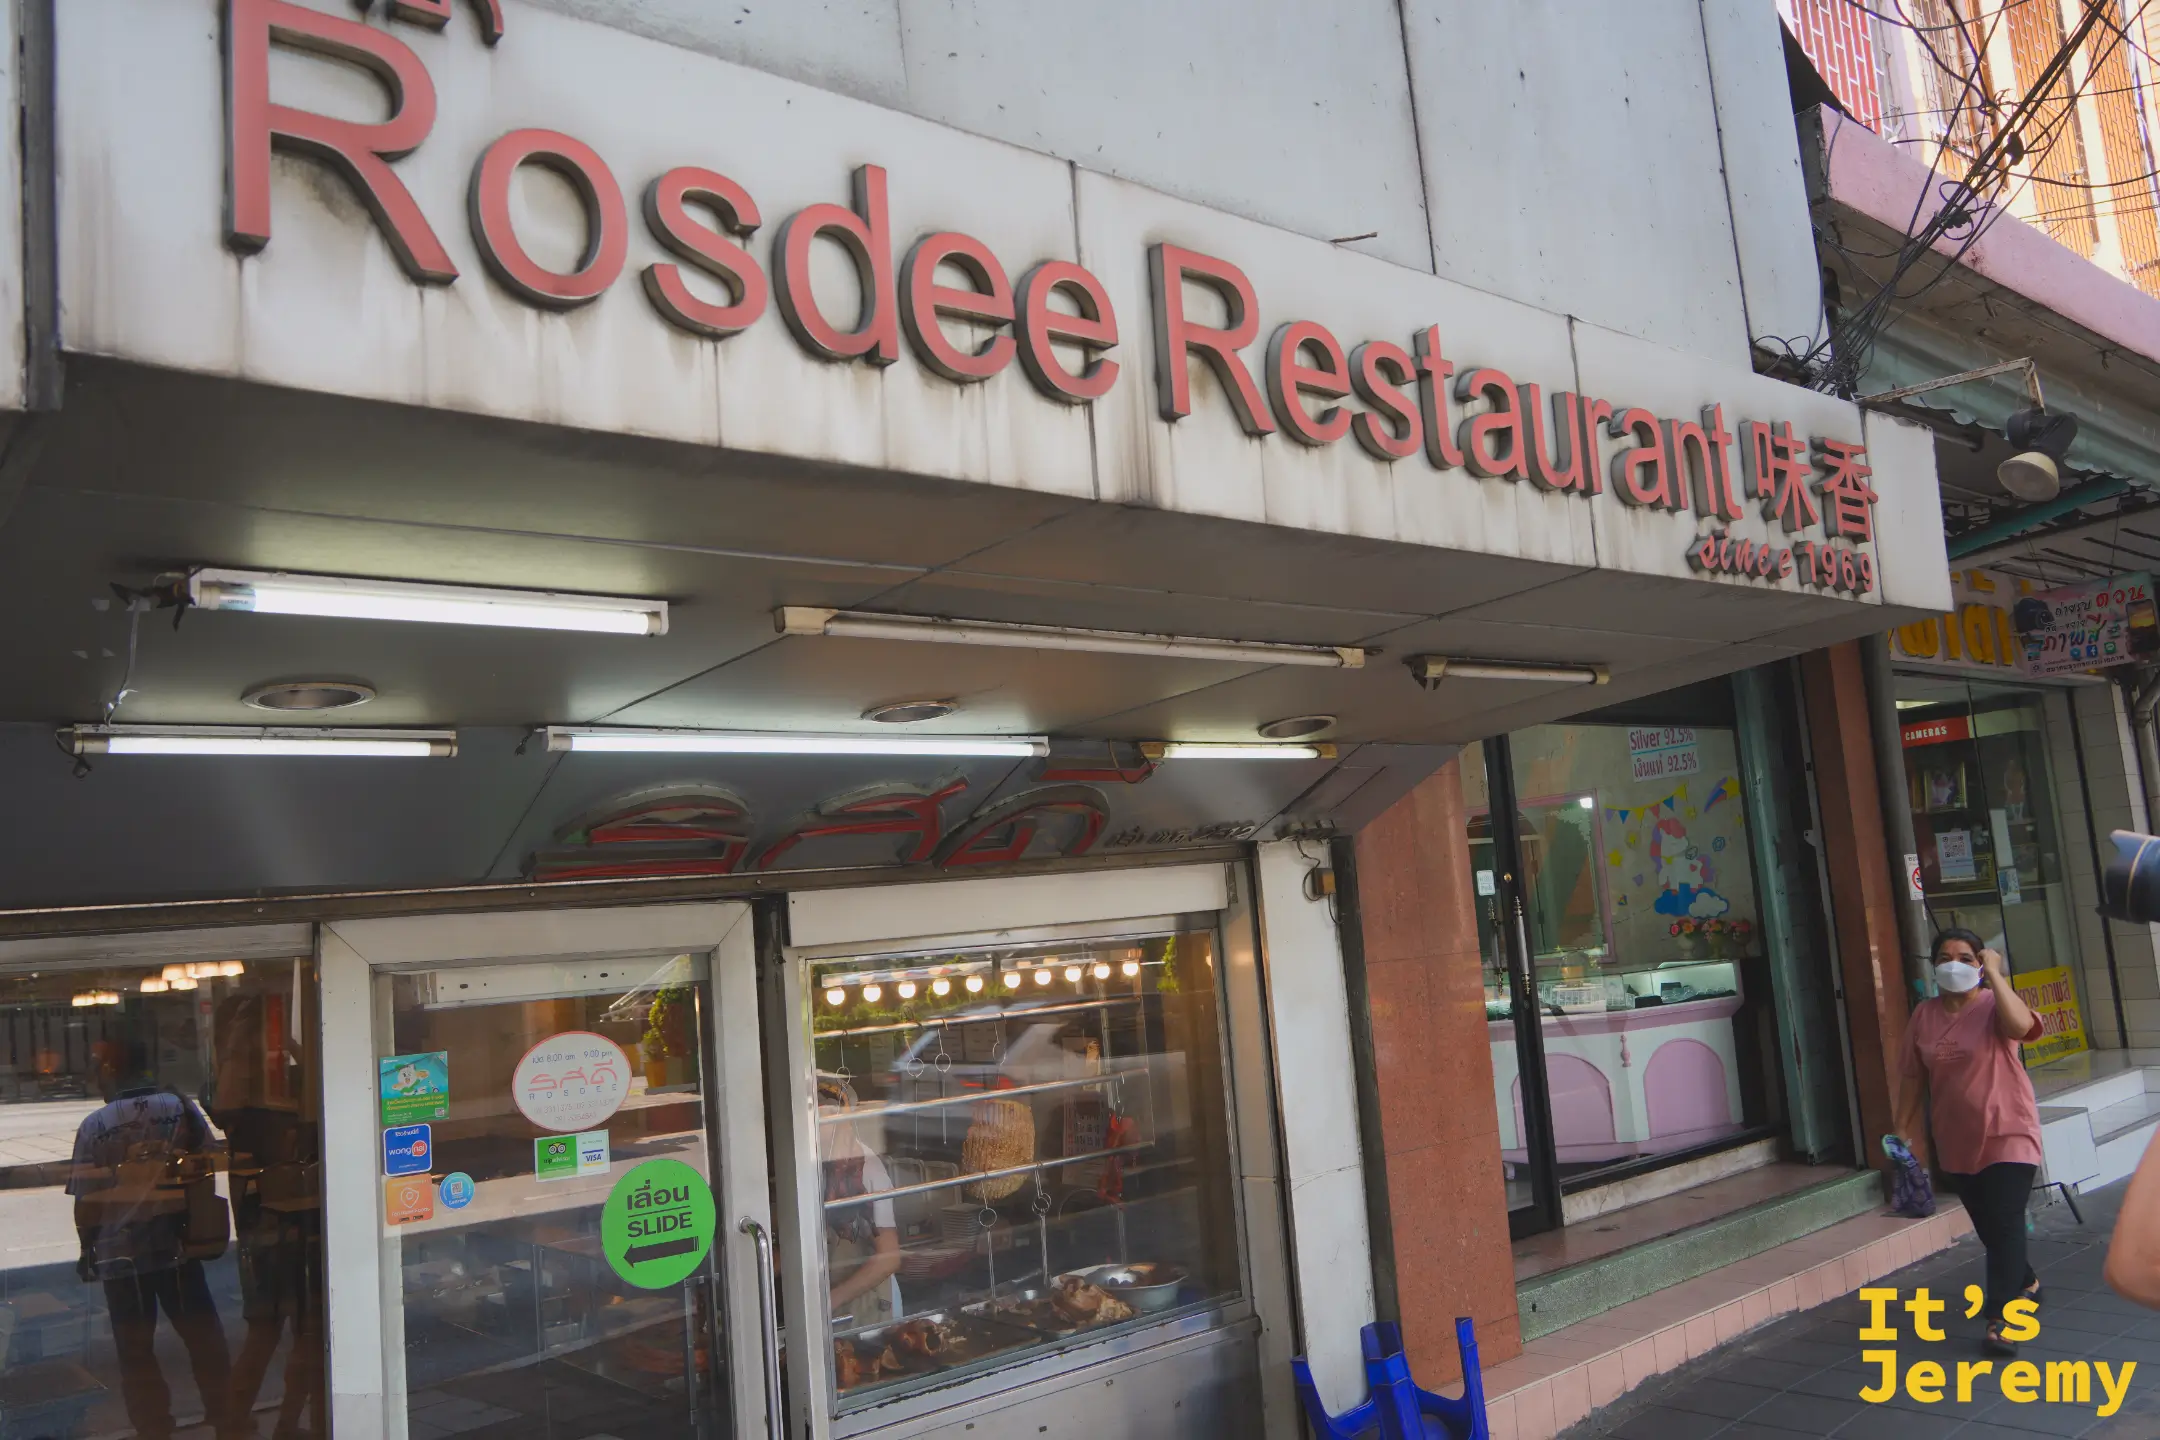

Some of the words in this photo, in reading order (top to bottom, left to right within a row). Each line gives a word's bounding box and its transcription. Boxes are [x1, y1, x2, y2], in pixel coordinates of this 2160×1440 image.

[228, 0, 1120, 402] Rosdee
[1149, 241, 1743, 521] Restaurant
[1743, 419, 1878, 544] 味香
[1690, 528, 1793, 579] since
[1800, 541, 1873, 594] 1969
[2096, 581, 2145, 607] ด่วน
[1630, 729, 1660, 750] Silver
[1664, 727, 1694, 745] 92.5%
[1905, 726, 1947, 740] CAMERAS
[1667, 751, 1697, 773] 92.5%
[585, 1153, 602, 1162] VISA
[626, 1179, 690, 1211] เลื่อน
[627, 1211, 693, 1238] SLIDE
